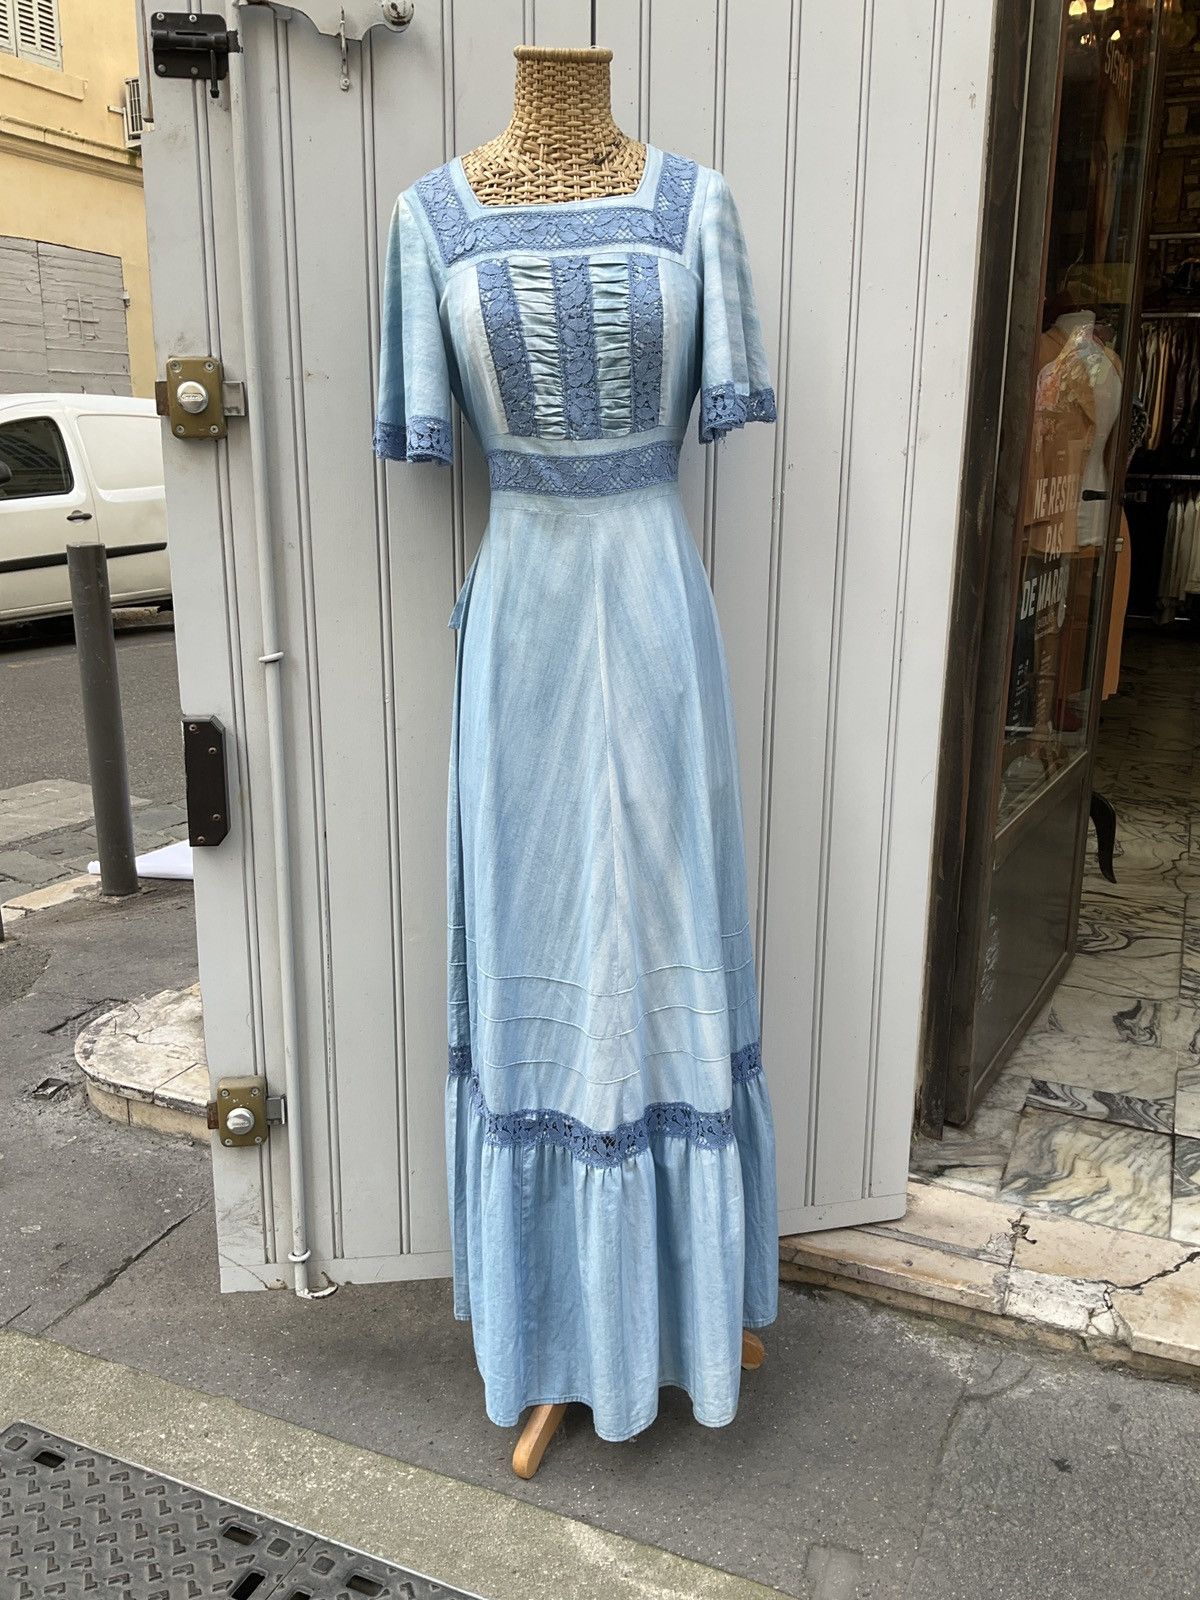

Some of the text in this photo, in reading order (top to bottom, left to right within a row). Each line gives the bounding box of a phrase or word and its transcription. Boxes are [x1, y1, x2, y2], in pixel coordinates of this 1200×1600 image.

[1033, 477, 1049, 520] NE
[1044, 523, 1064, 563] PAS
[1020, 565, 1067, 621] DE MARB
